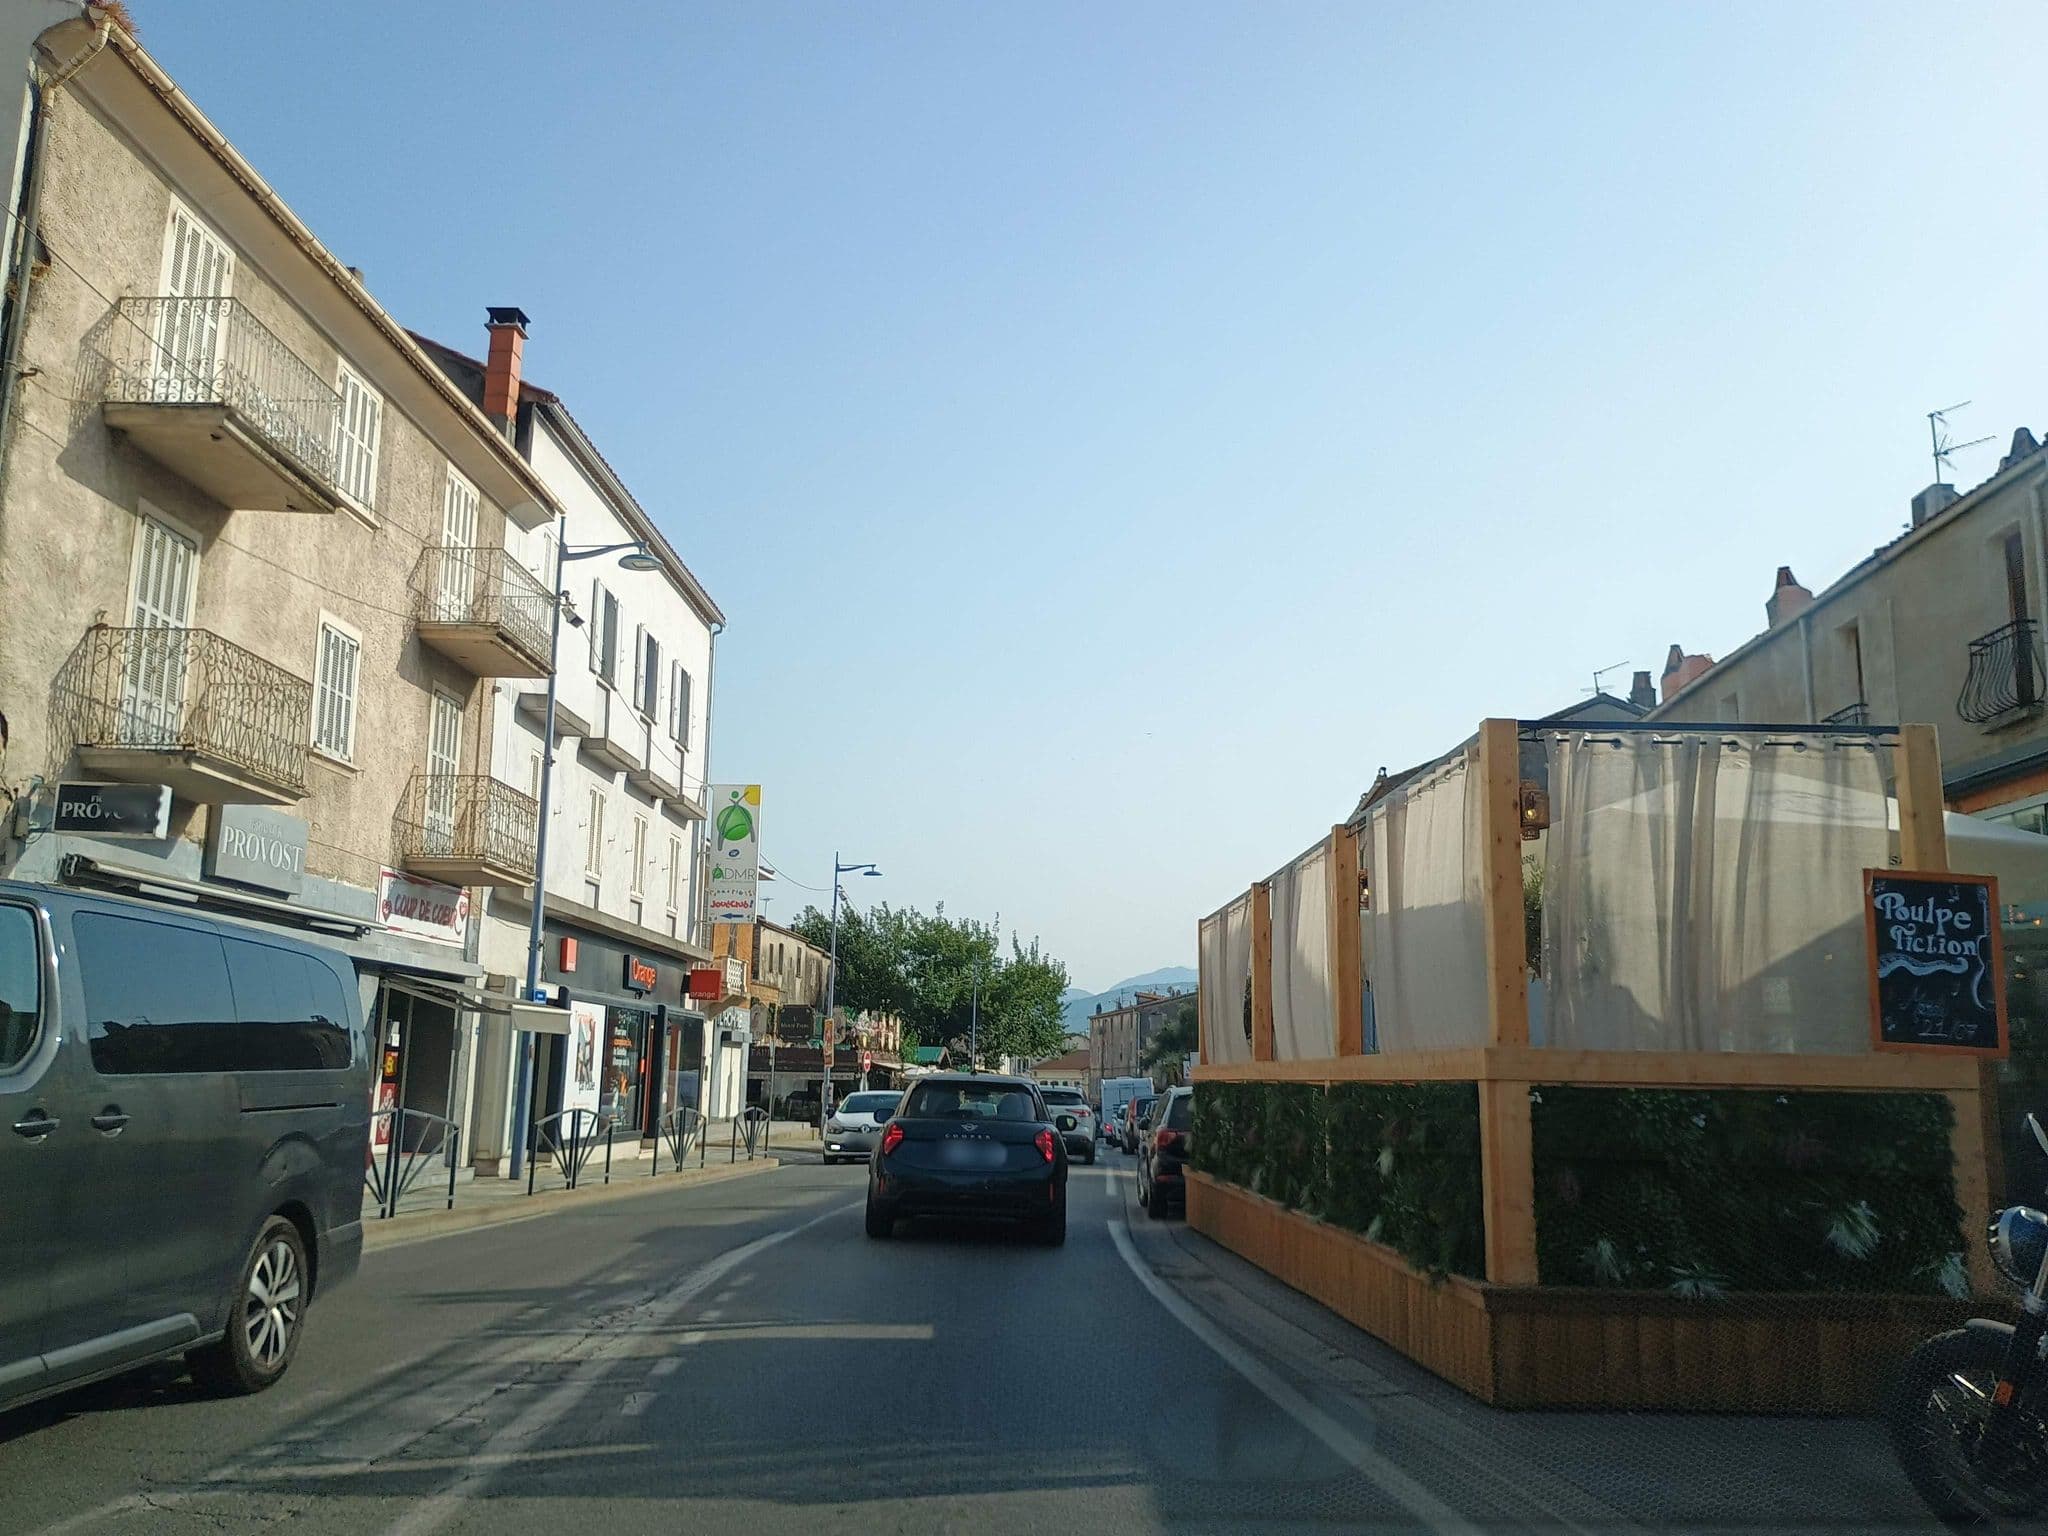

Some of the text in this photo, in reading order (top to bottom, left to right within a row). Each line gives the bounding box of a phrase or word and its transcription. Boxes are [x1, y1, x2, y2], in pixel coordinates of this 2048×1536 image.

[221, 825, 303, 873] PROVOST
[712, 863, 755, 881] ADMR
[394, 894, 418, 919] COUP
[419, 899, 432, 921] DE
[1874, 892, 1972, 936] Poulpe
[1890, 923, 1978, 956] Fiction
[631, 957, 656, 989] Orange
[690, 991, 716, 999] orange
